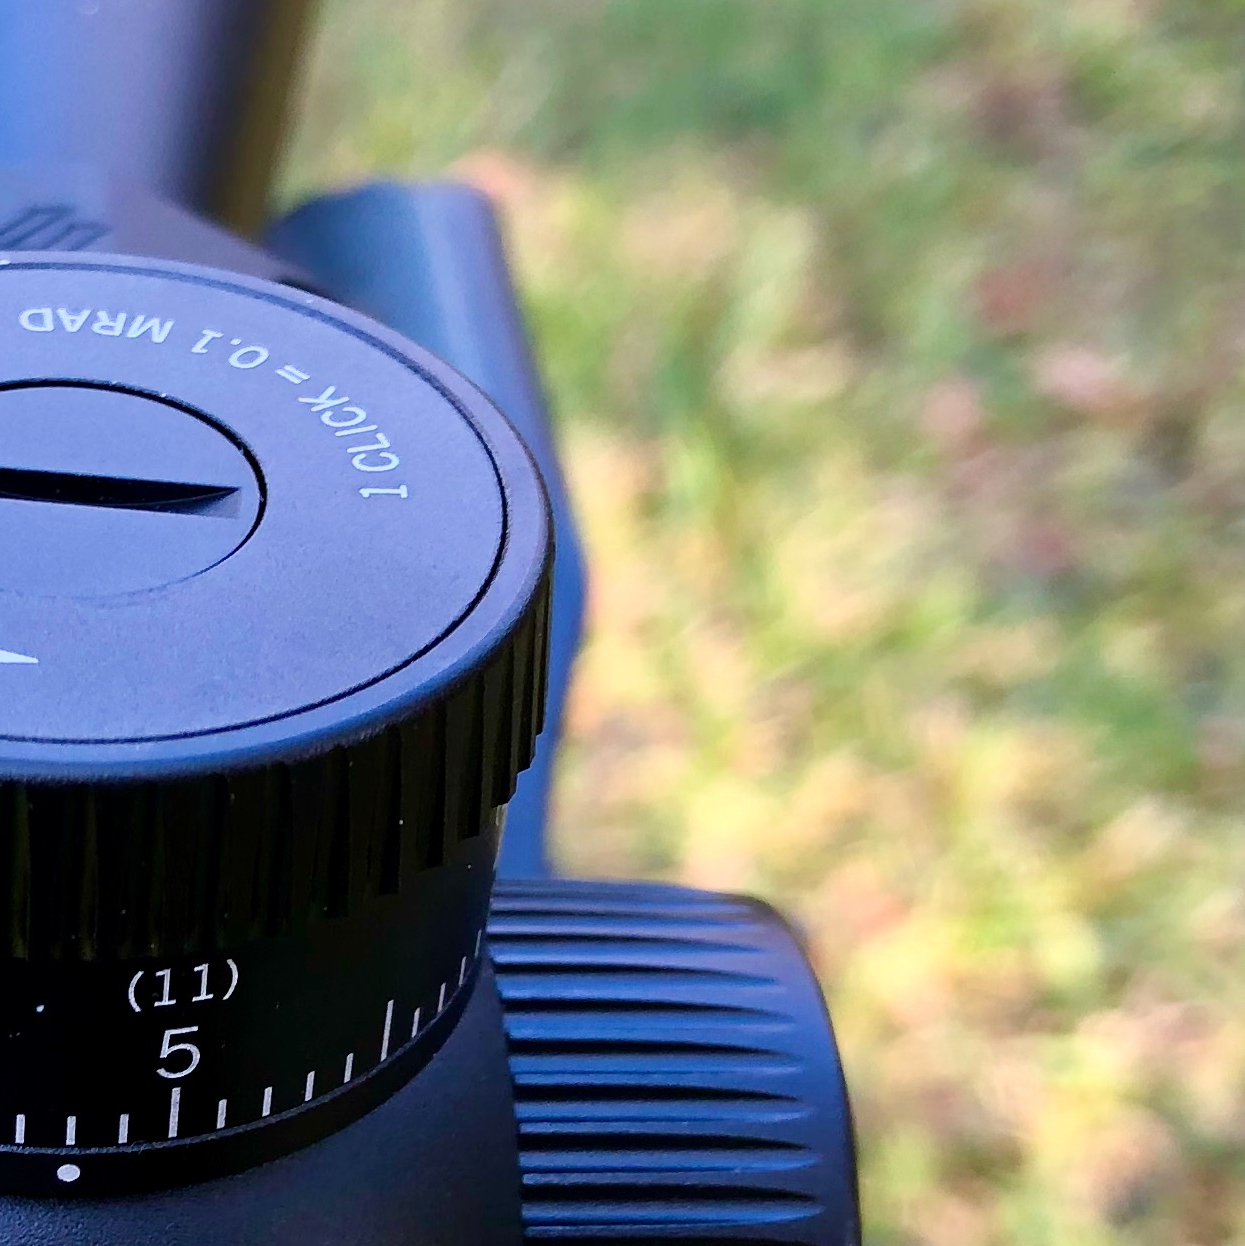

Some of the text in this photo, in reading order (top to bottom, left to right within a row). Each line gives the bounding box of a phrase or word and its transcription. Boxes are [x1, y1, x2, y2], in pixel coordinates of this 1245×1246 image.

[19, 306, 175, 343] MRAD
[191, 329, 270, 368] 0.1
[298, 386, 400, 472] CLICK
[358, 484, 409, 499] 1
[128, 958, 239, 1013] (11)
[156, 1025, 201, 1078] 5
